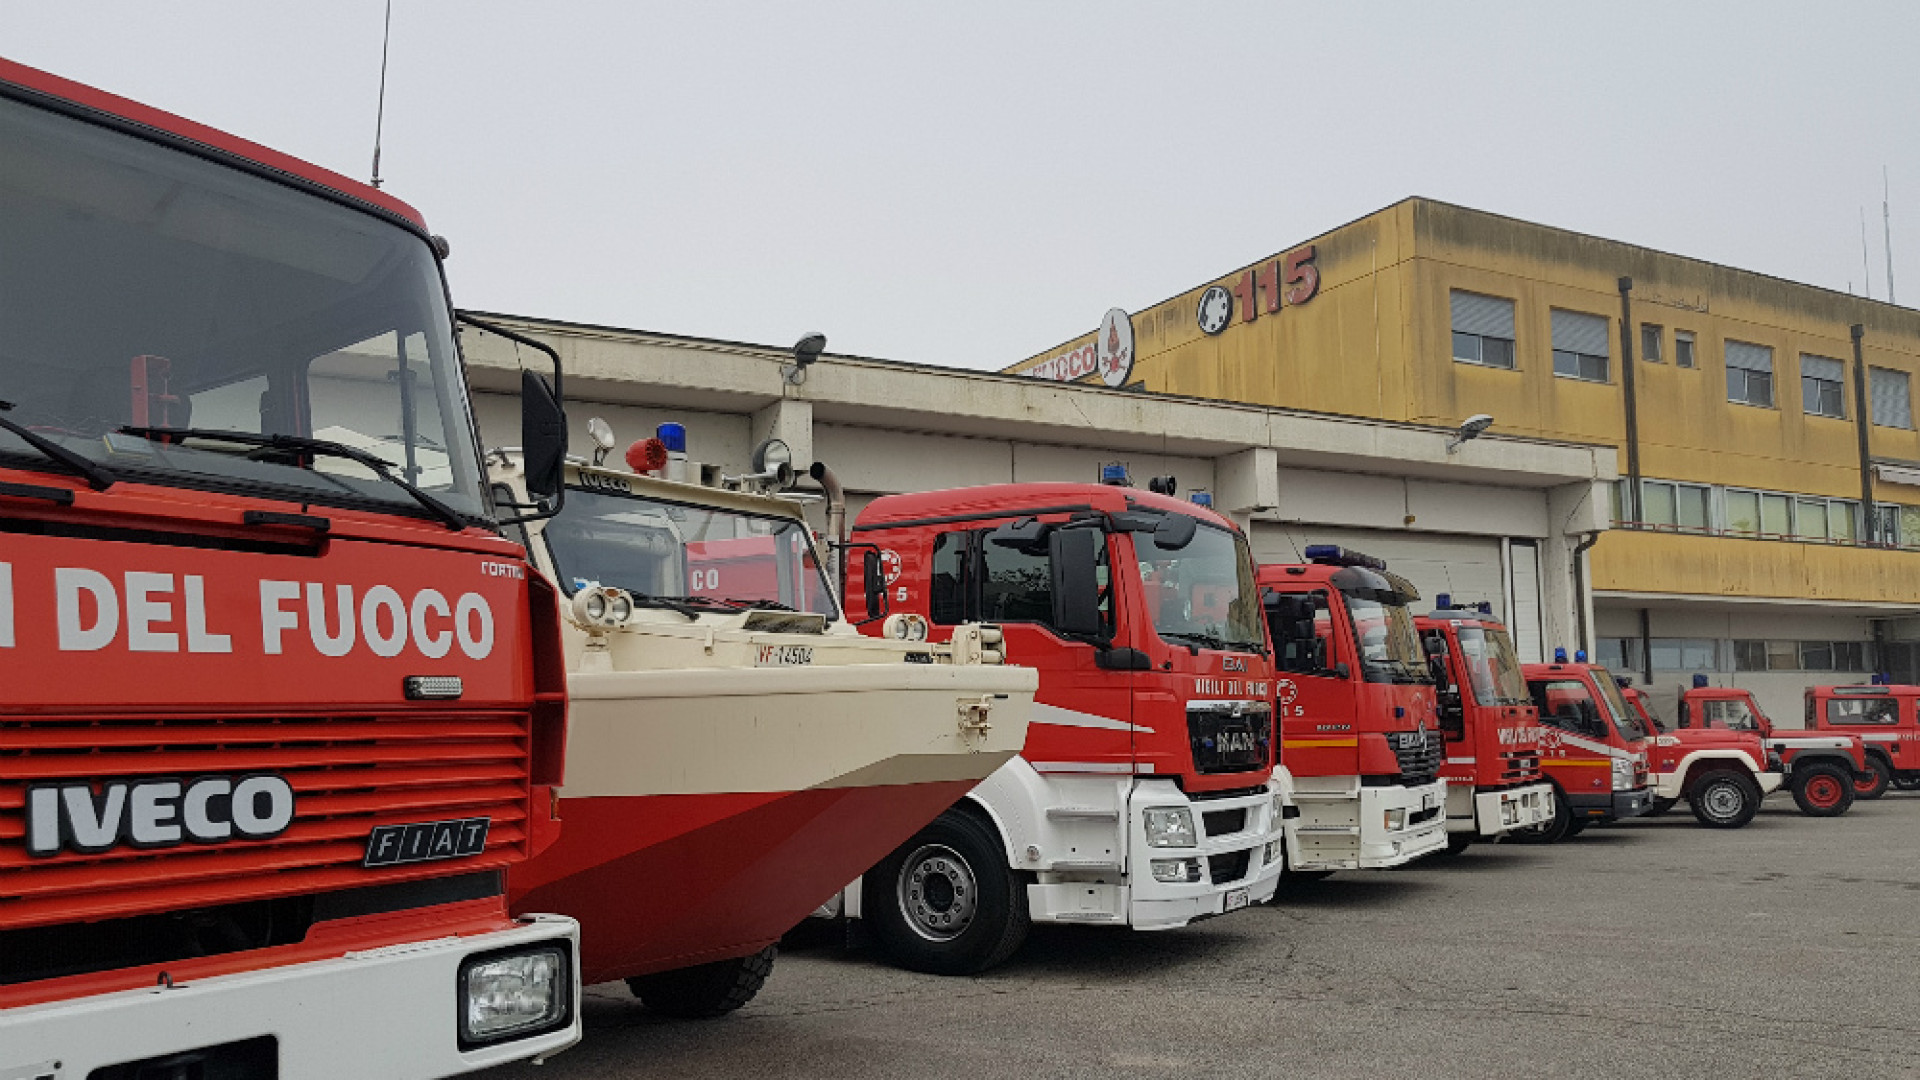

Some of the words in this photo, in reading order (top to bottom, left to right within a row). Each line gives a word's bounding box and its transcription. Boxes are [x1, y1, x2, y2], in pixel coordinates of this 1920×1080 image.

[1235, 245, 1320, 322] 115
[55, 567, 233, 653] DEL
[259, 579, 495, 660] FUOCO
[31, 776, 294, 852] IVECO
[376, 823, 483, 858] FIAT
